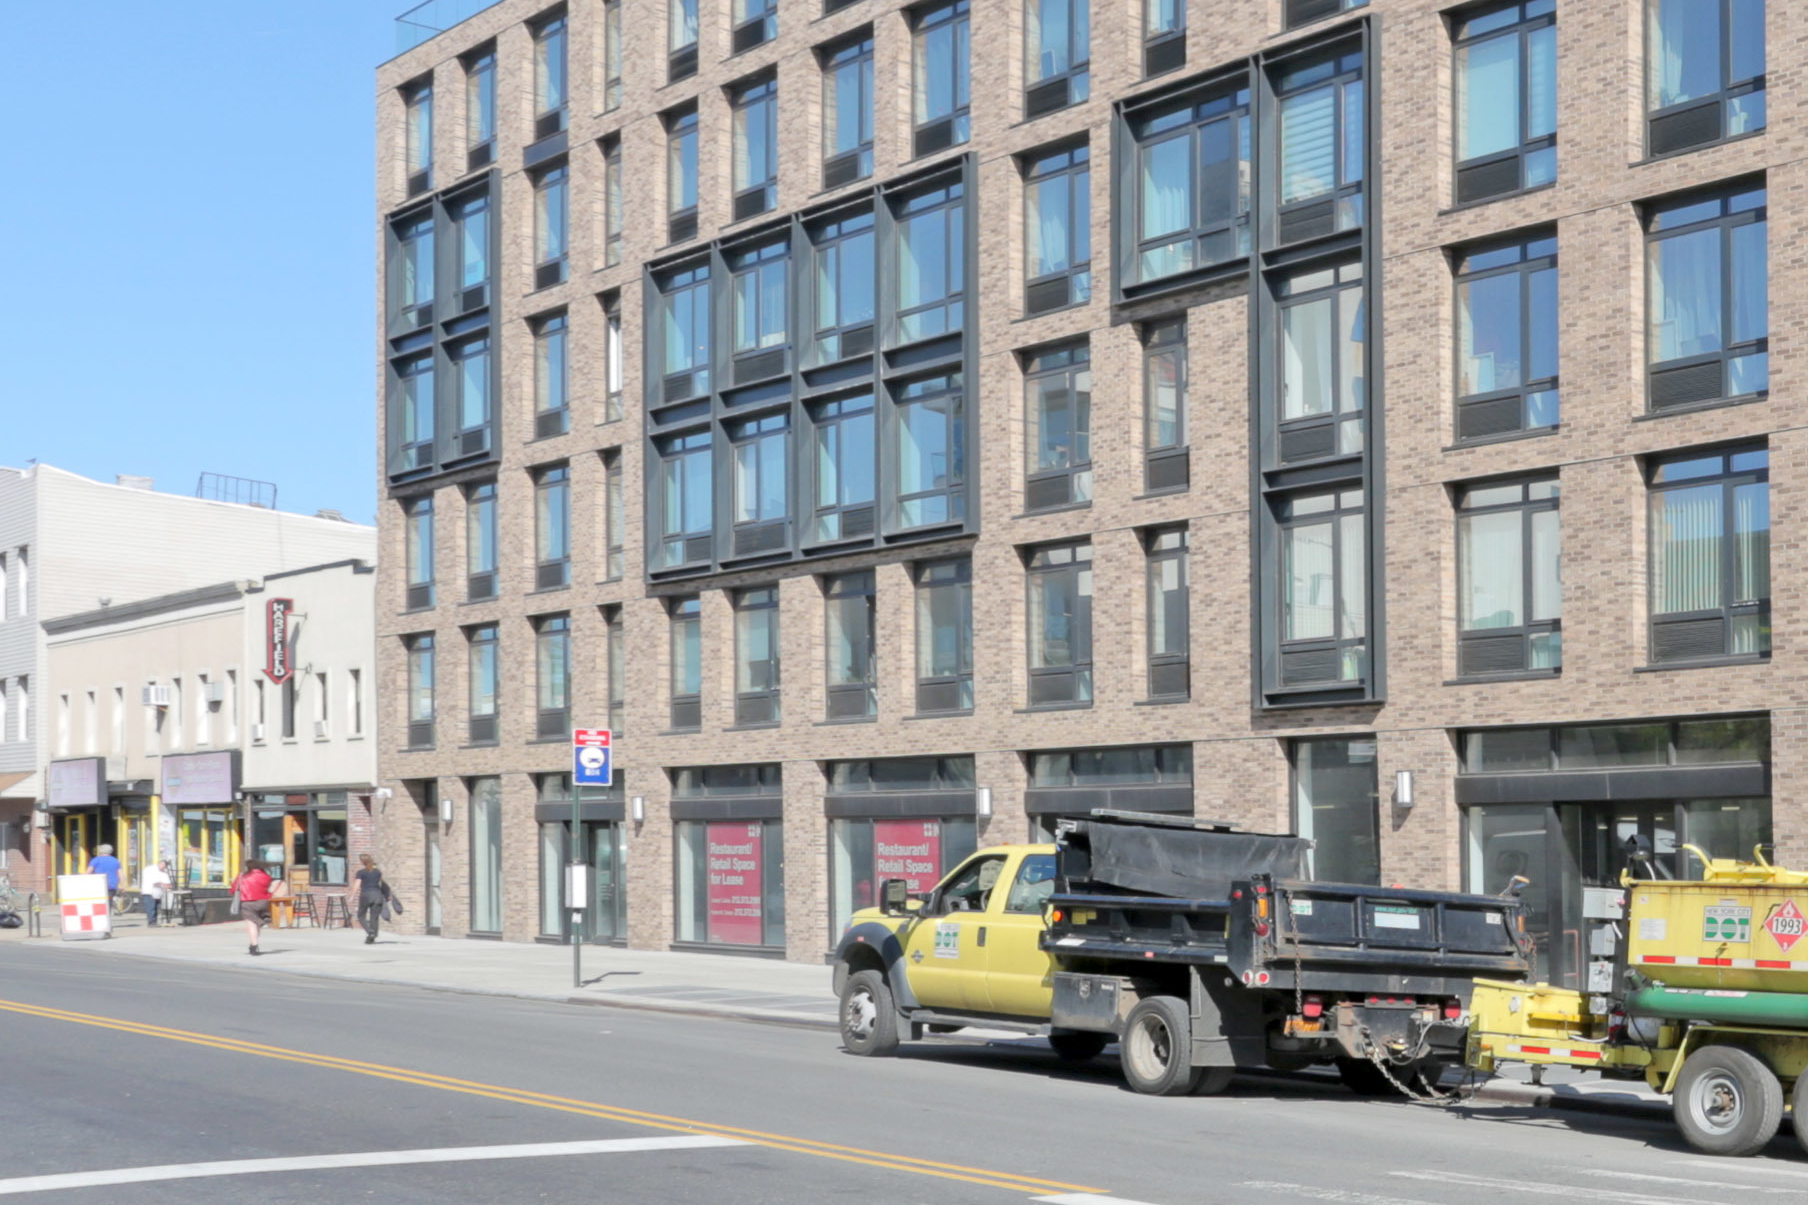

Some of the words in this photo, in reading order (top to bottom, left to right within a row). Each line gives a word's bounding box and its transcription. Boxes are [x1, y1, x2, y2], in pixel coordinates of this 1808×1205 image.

[710, 842, 753, 854] Restaurant/
[878, 842, 929, 856] Restaurant/
[710, 857, 731, 870] Retail
[732, 857, 756, 873] Space
[878, 859, 904, 872] Retail
[906, 859, 933, 876] Space
[711, 873, 721, 885] for
[722, 873, 744, 886] Lease
[1705, 916, 1750, 940] DOT
[1775, 918, 1802, 934] 1993
[936, 931, 959, 948] DOT
